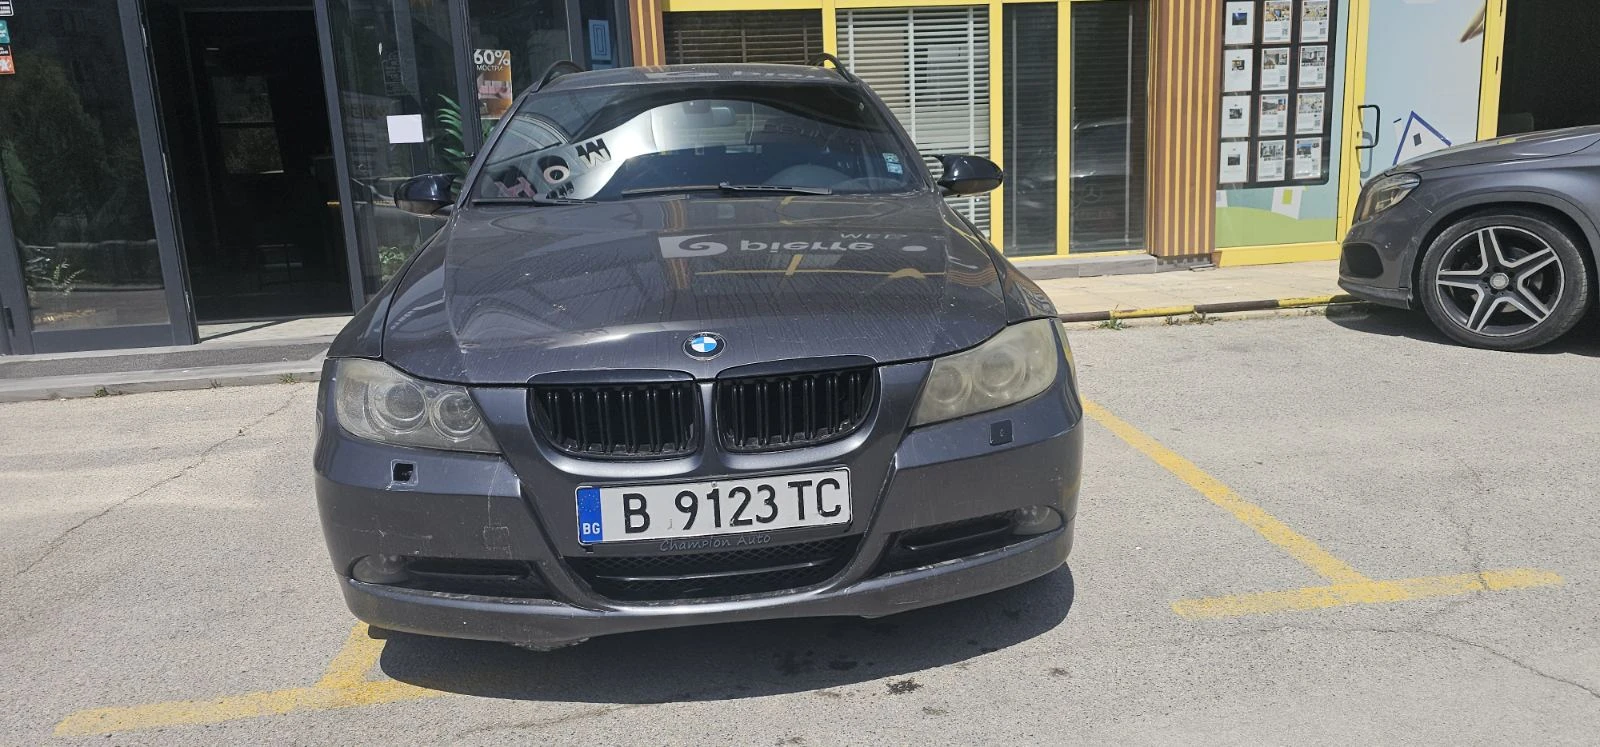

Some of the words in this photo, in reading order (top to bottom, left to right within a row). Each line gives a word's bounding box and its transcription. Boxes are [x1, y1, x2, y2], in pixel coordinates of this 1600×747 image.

[473, 49, 511, 65] 60%
[622, 493, 650, 534] B
[674, 484, 779, 531] 9123
[787, 478, 842, 521] TC
[582, 522, 601, 535] BG
[659, 538, 731, 552] Champion
[736, 534, 771, 545] Auto
